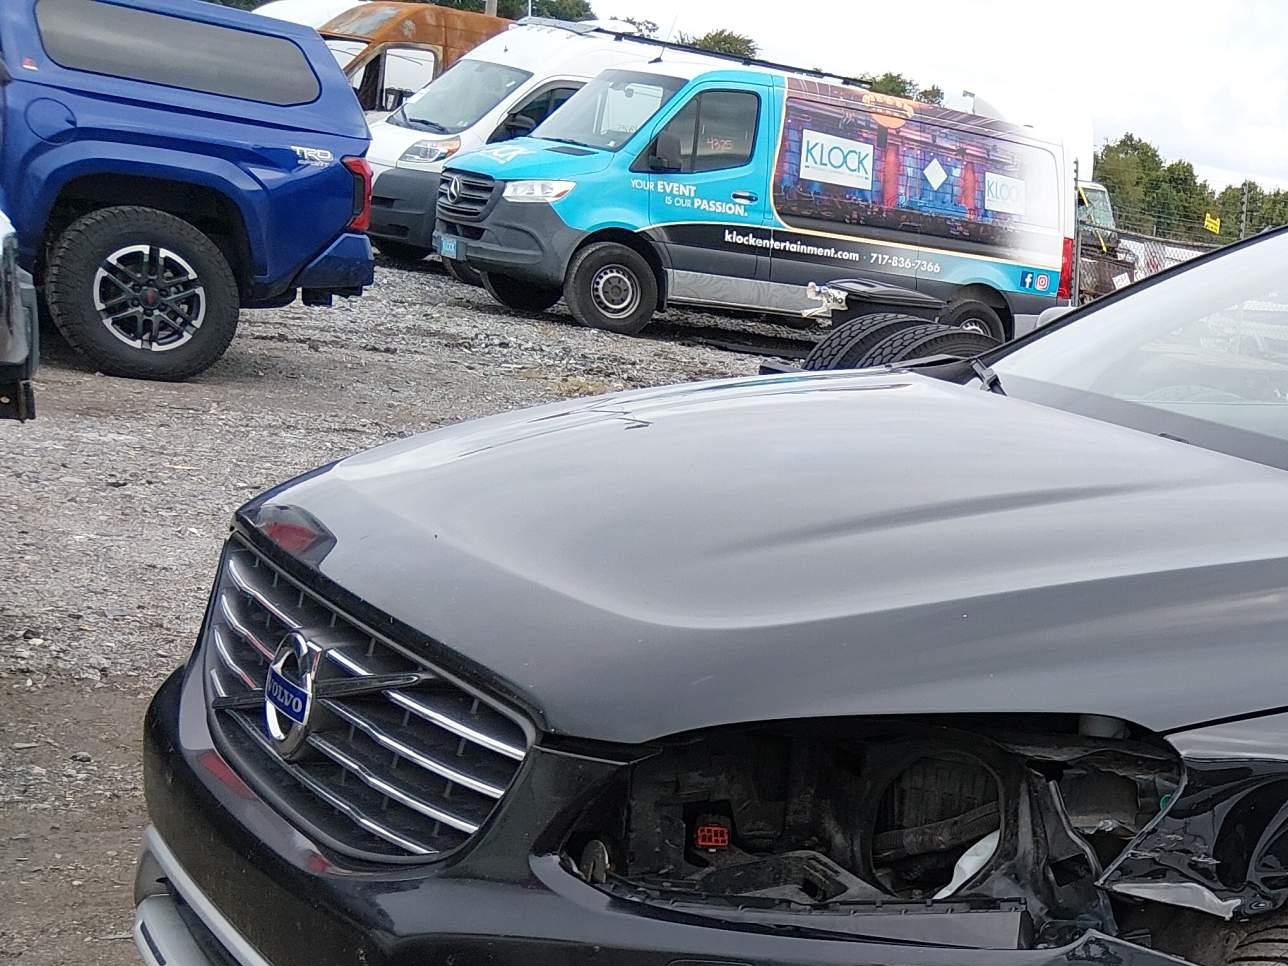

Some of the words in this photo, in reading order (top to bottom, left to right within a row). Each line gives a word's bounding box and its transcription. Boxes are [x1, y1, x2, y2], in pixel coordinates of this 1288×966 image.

[805, 139, 869, 174] KLOCK
[631, 178, 655, 193] YOUR
[657, 180, 697, 196] EVENT
[664, 195, 673, 207] IS
[674, 196, 692, 209] OUR
[693, 198, 749, 217] PASSION.
[724, 229, 860, 262] klockentertainment.com
[869, 252, 941, 273] 717-836-7366
[267, 678, 303, 713] VOLVO
